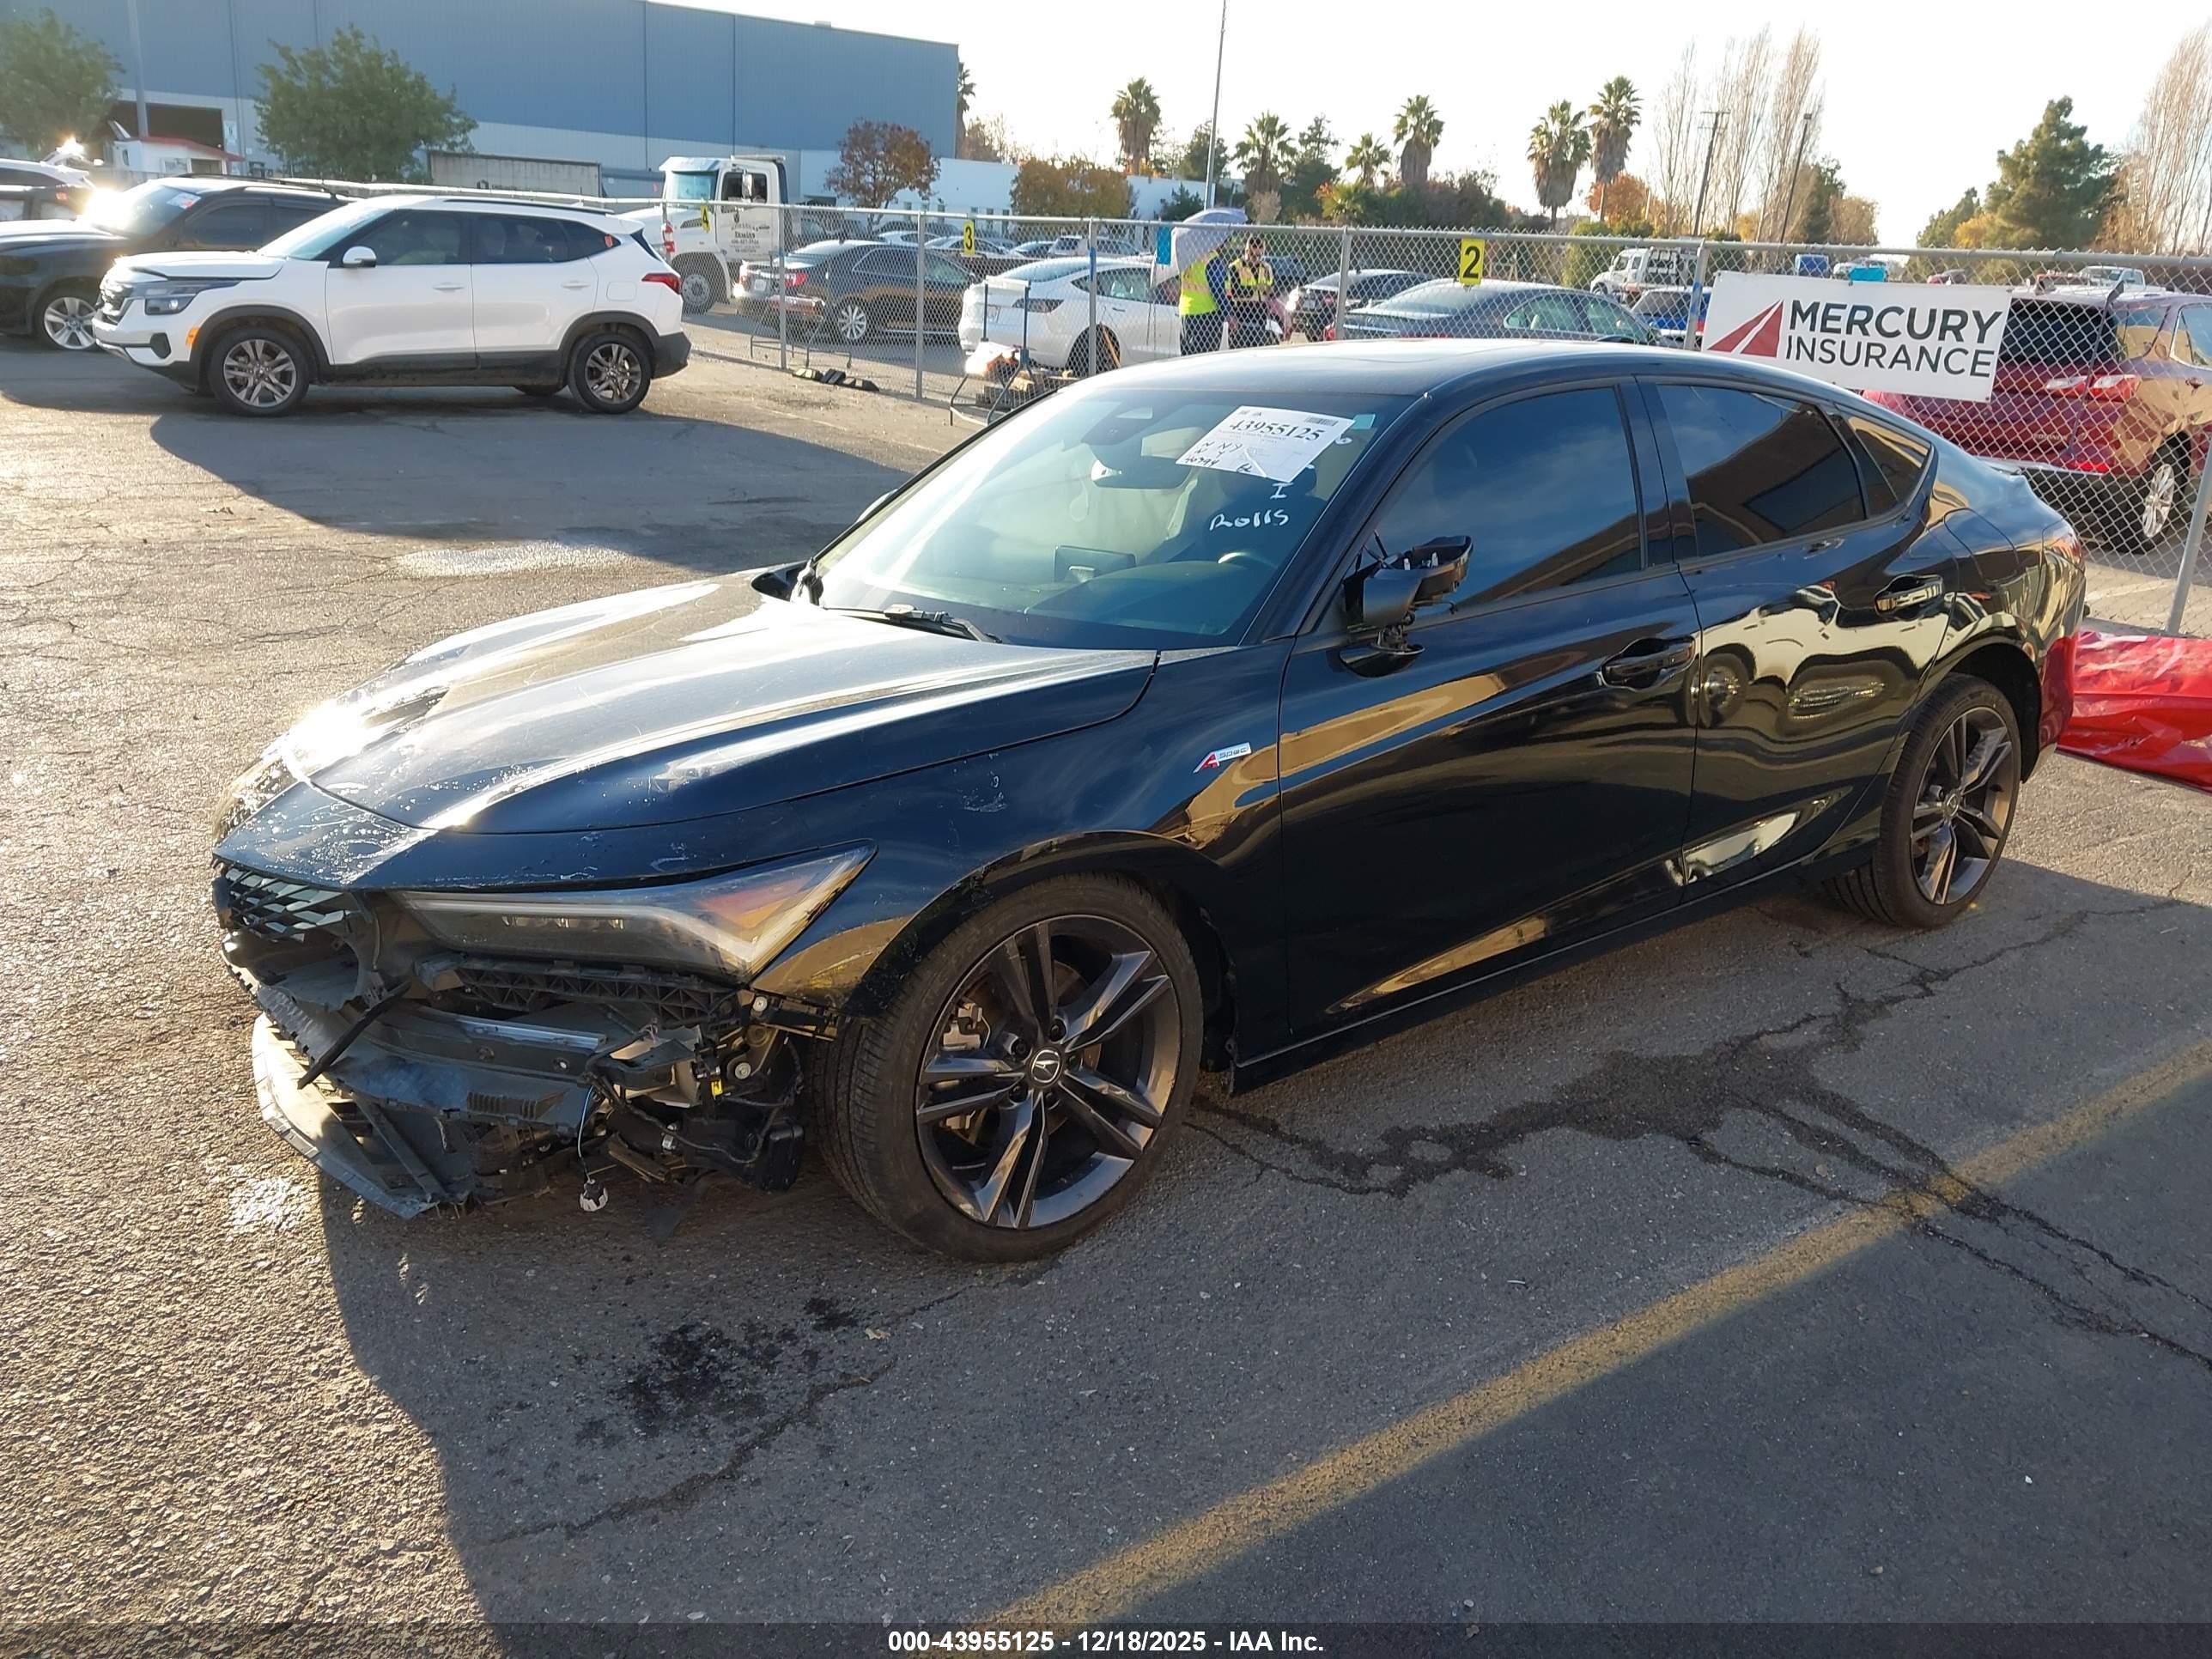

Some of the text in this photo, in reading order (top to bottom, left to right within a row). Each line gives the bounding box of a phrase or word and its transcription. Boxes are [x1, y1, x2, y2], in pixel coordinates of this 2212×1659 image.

[702, 208, 709, 228] 4
[965, 226, 973, 250] 3
[1462, 246, 1480, 279] 2
[1789, 300, 2002, 344] MERCURY
[1785, 334, 1995, 378] INSURANCE
[1229, 419, 1326, 441] 43955125
